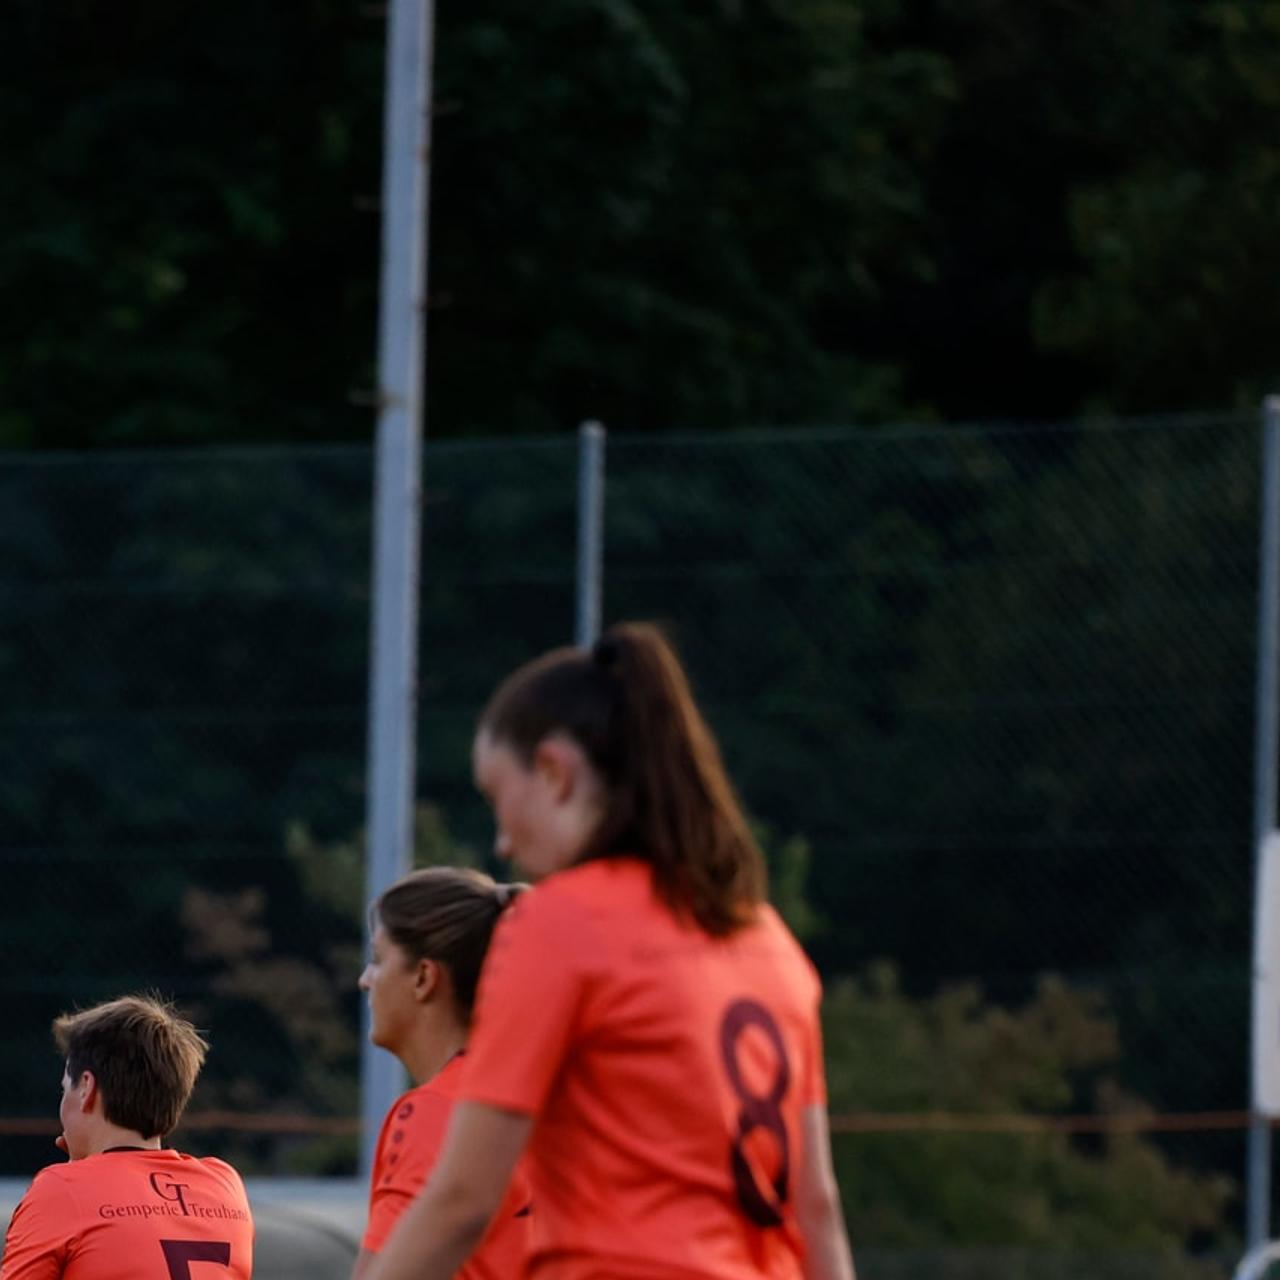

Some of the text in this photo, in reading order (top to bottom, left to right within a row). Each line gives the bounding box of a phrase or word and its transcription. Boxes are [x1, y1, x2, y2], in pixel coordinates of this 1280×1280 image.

[719, 999, 792, 1228] 8
[98, 1202, 180, 1220] Gemperle
[149, 1171, 190, 1216] GT
